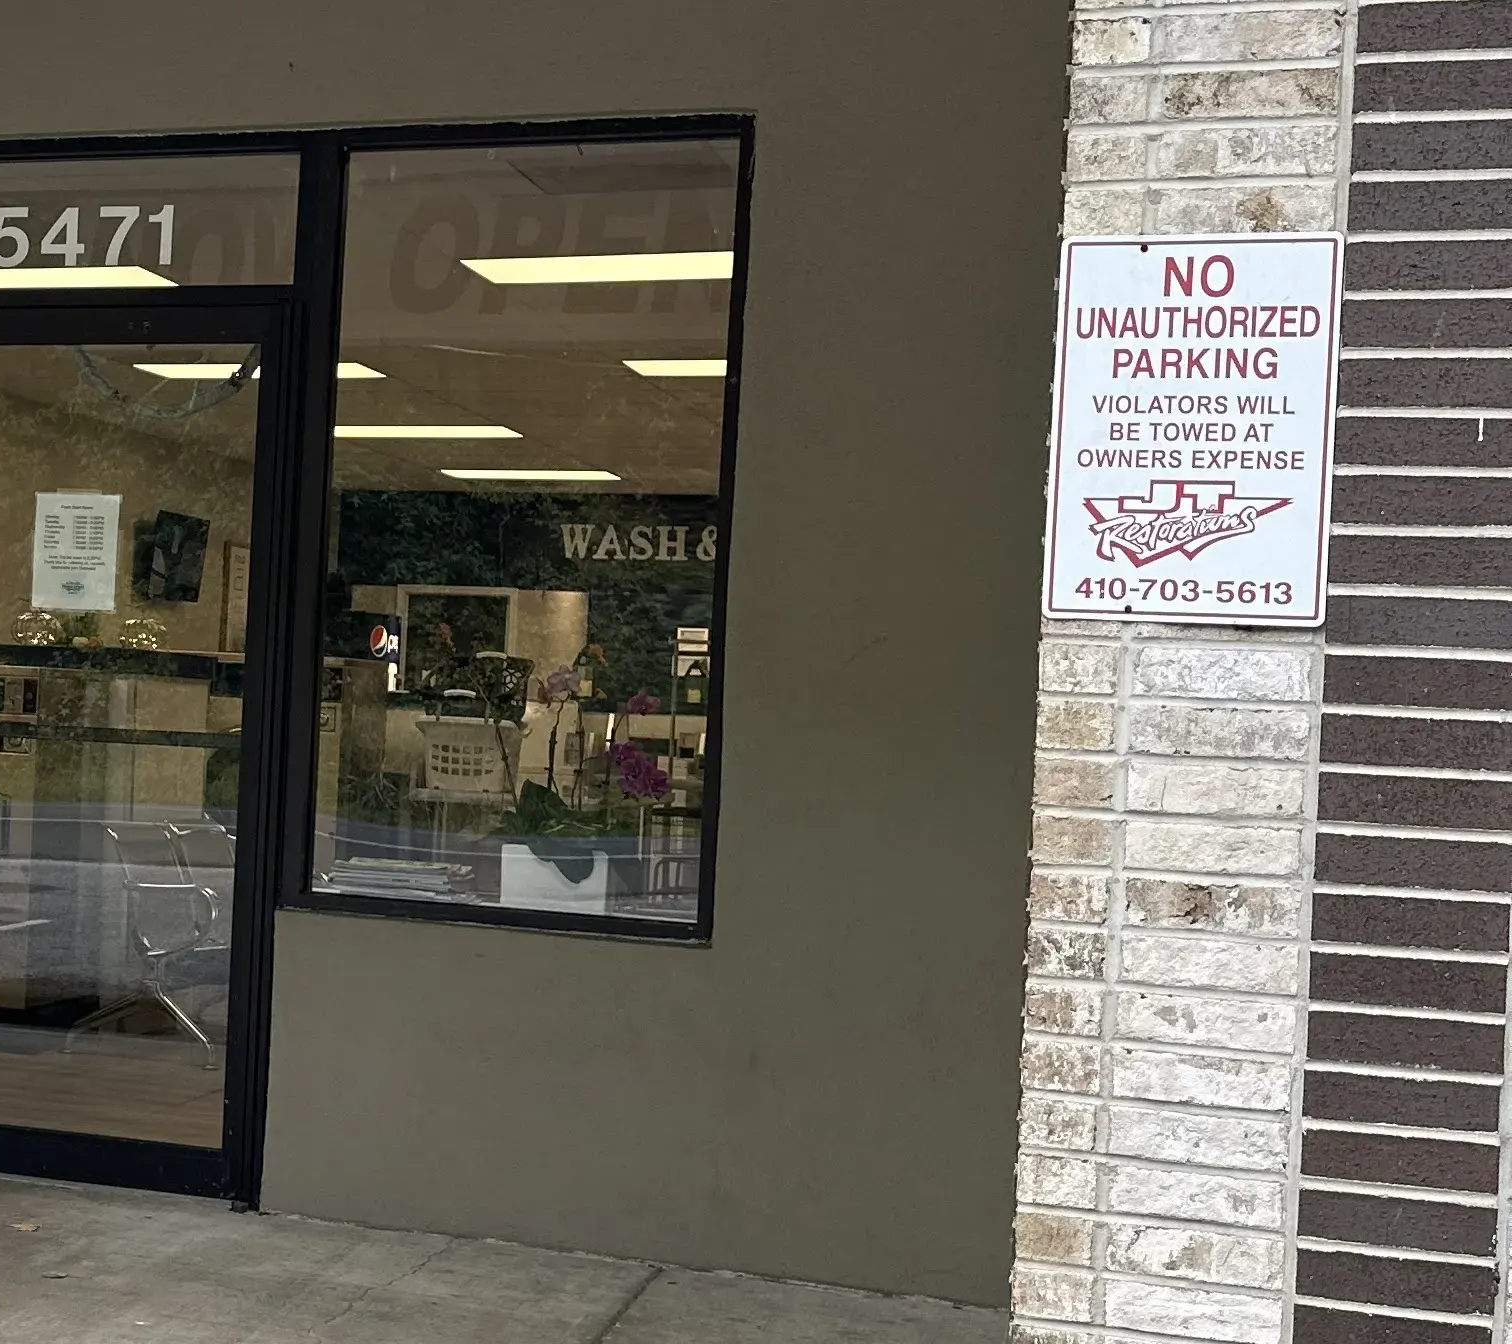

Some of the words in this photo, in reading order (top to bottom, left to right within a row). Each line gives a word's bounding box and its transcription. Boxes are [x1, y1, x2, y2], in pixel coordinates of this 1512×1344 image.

[1163, 254, 1235, 298] NO
[1076, 305, 1321, 340] UNAUTHORIZED
[1112, 347, 1278, 380] PARKING
[1092, 395, 1228, 415] VIOLATORS
[1236, 395, 1296, 415] WILL
[1109, 422, 1141, 442] BE
[1149, 422, 1236, 443] TOWED
[1243, 423, 1274, 443] AT
[1077, 448, 1182, 469] OWNERS
[1191, 450, 1305, 470] EXPENSE
[560, 523, 689, 561] WASH
[1074, 577, 1293, 605] 410-703-5613
